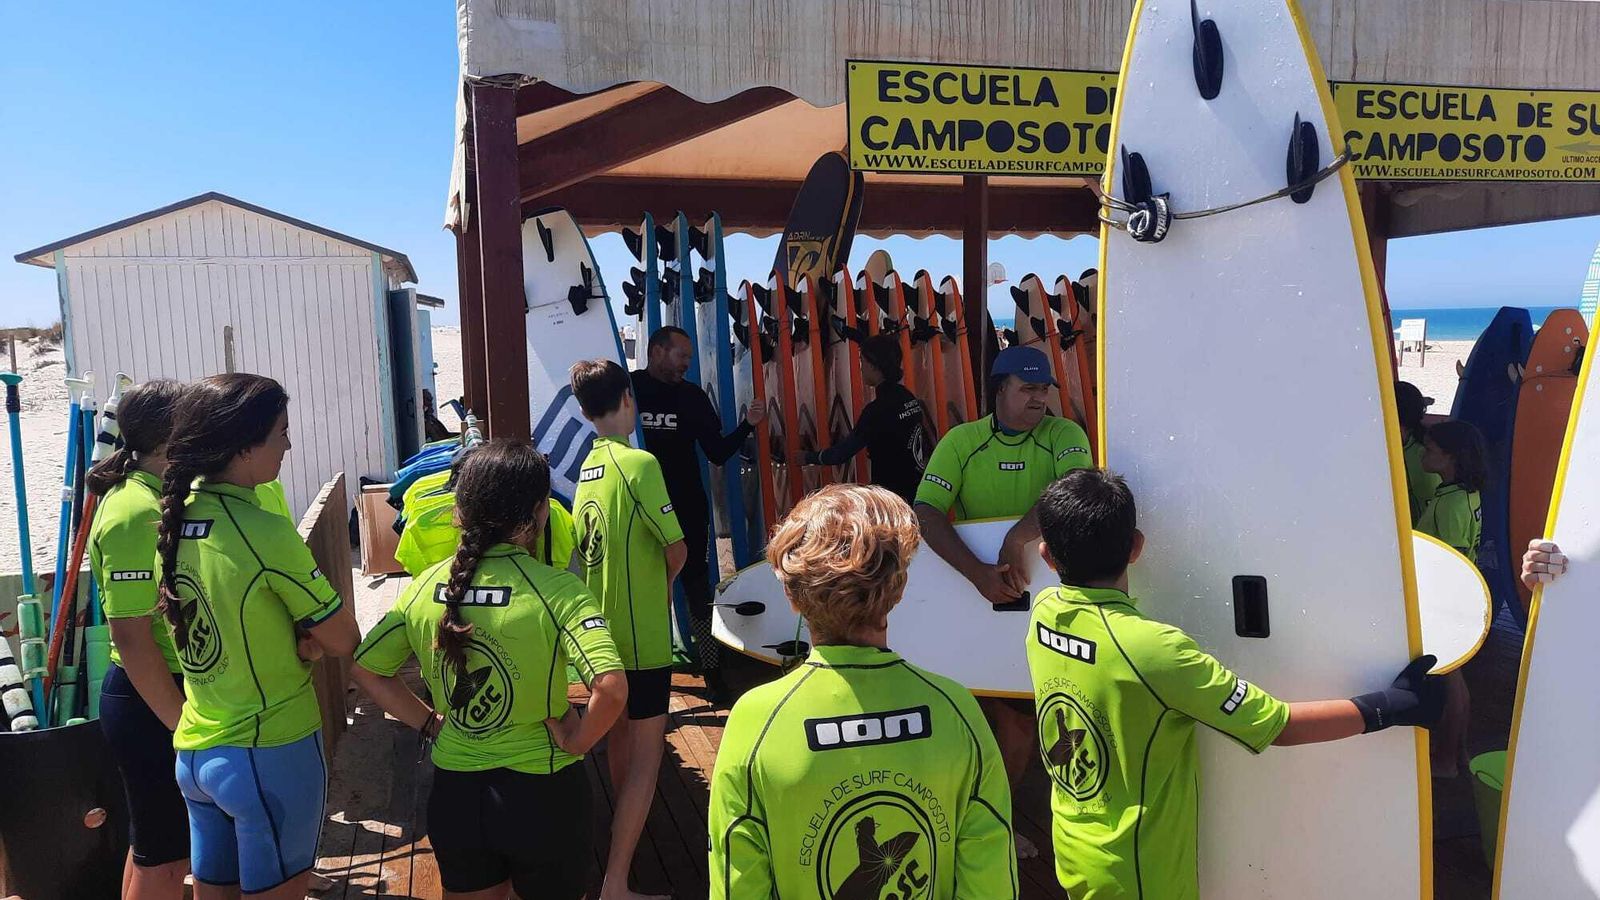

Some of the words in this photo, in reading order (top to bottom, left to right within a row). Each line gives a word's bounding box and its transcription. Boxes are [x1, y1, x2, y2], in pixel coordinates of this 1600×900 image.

[878, 70, 1060, 108] ESCUELA
[1356, 90, 1497, 122] ESCUELA
[1517, 102, 1553, 128] DE
[864, 153, 1107, 172] WWW.ESCUELADESURFCAMPO
[1344, 130, 1546, 163] CAMPOSOTO
[799, 798, 833, 867] ESCUELA
[833, 782, 853, 801] DE
[852, 769, 892, 790] SURF
[893, 771, 951, 844] CAMPOSOTO
